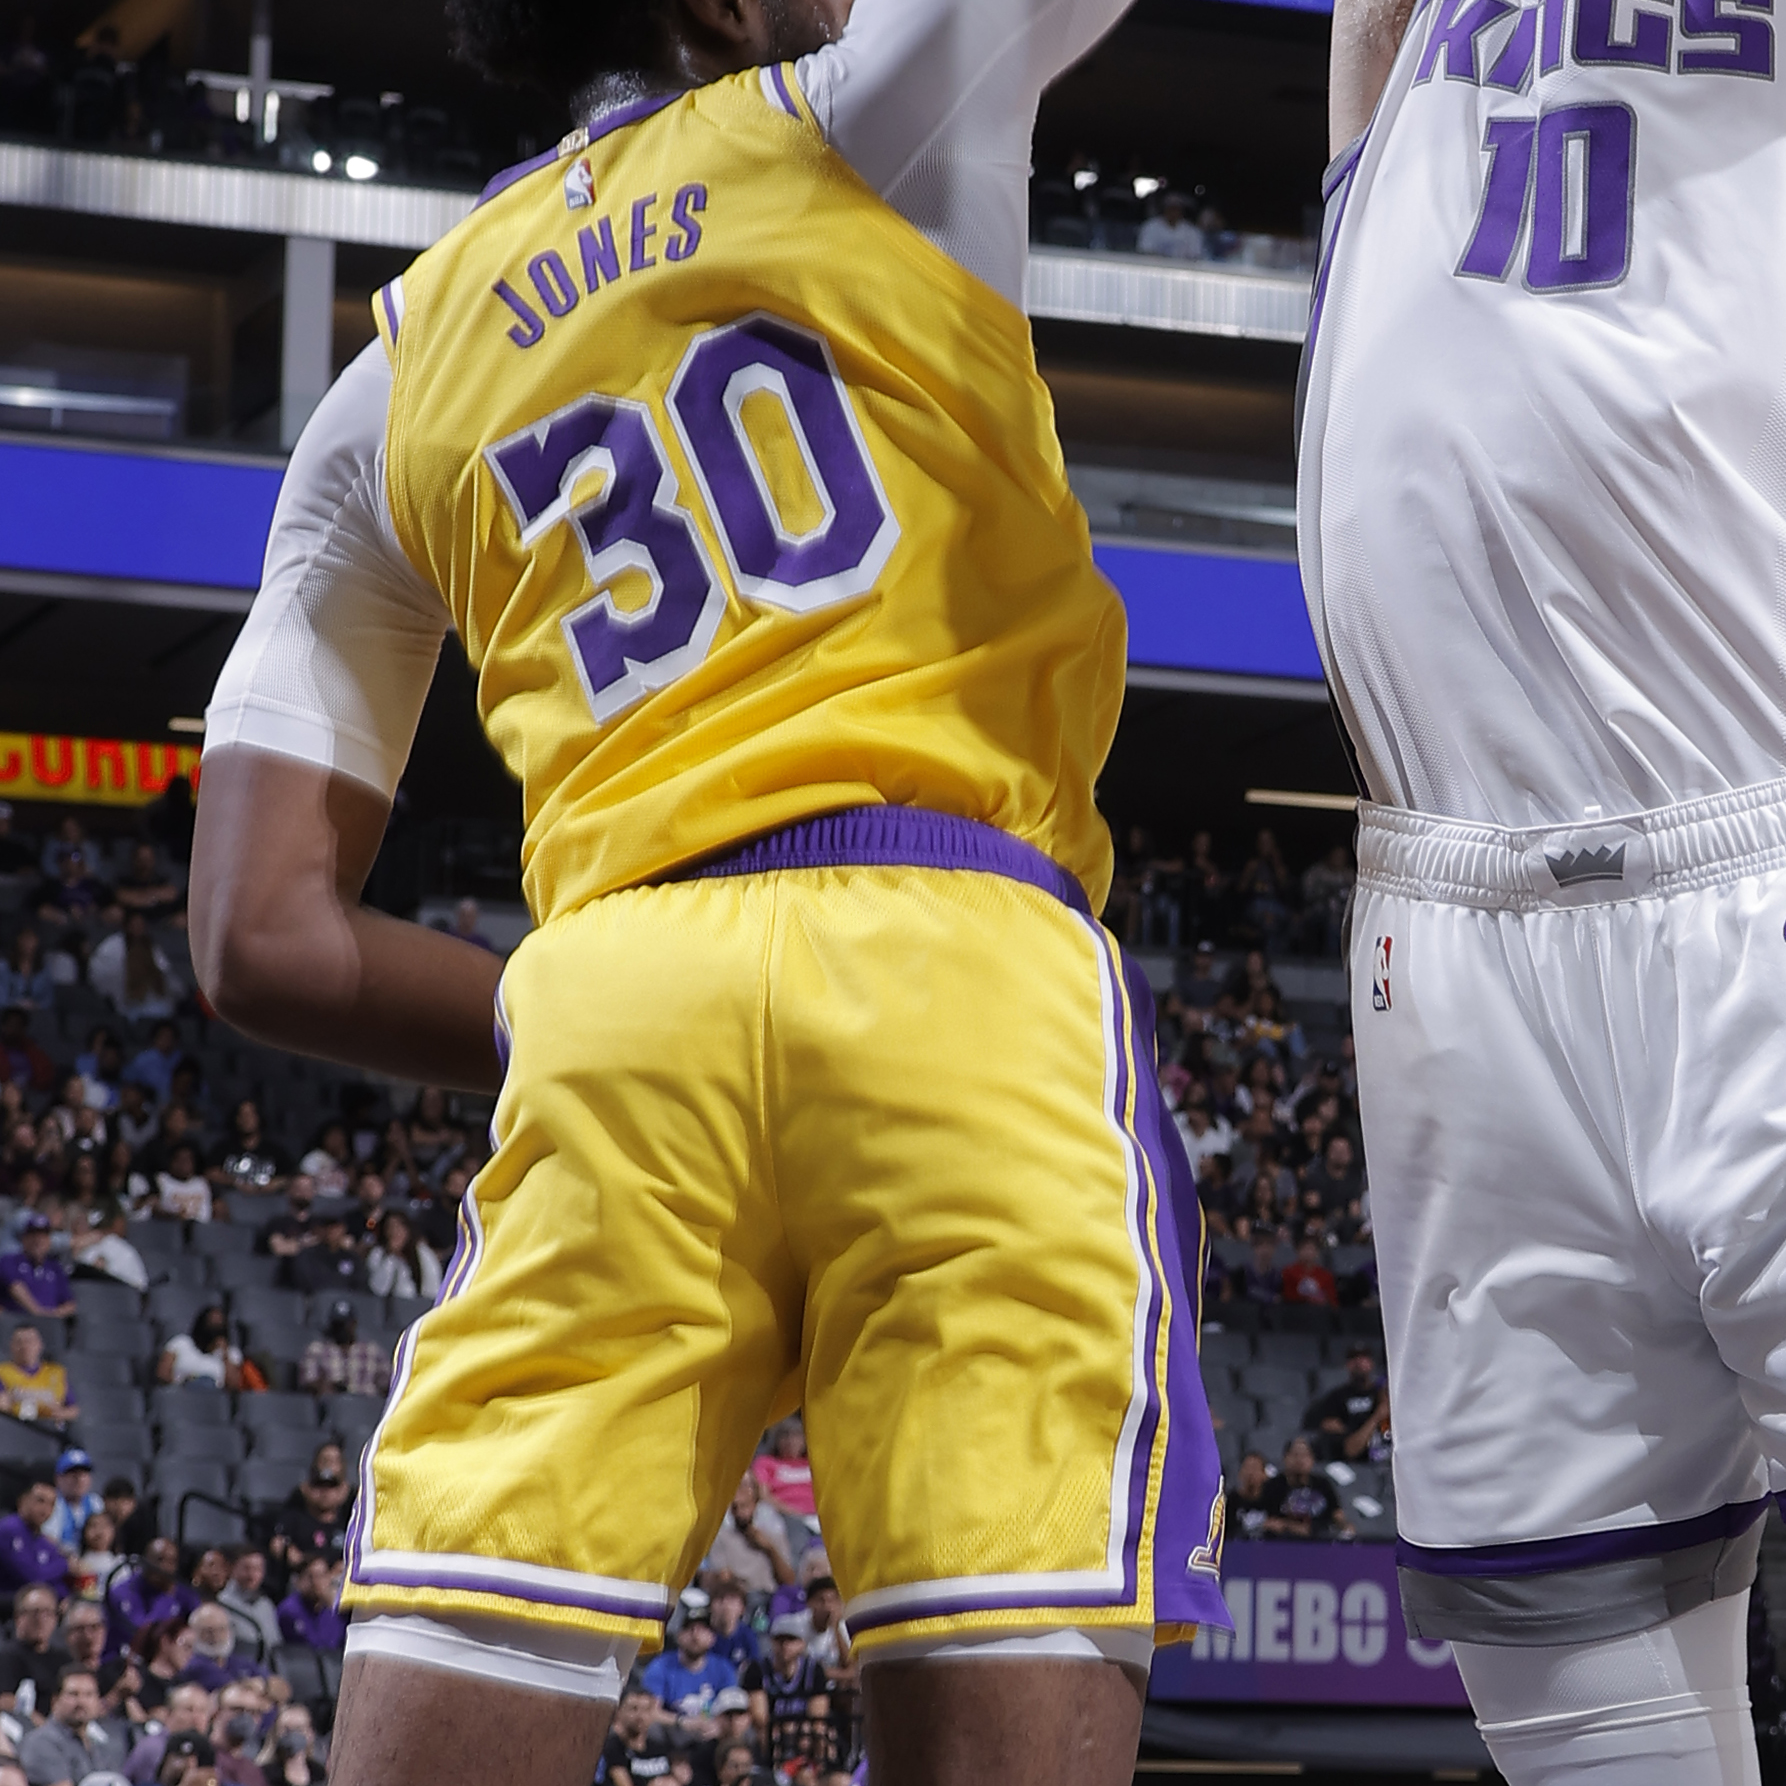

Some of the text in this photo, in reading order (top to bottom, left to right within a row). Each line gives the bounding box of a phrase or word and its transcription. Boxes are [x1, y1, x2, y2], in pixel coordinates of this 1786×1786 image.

[492, 182, 708, 349] JONES
[568, 193, 586, 209] NBA
[1453, 100, 1638, 296] 10
[483, 308, 901, 726] 30
